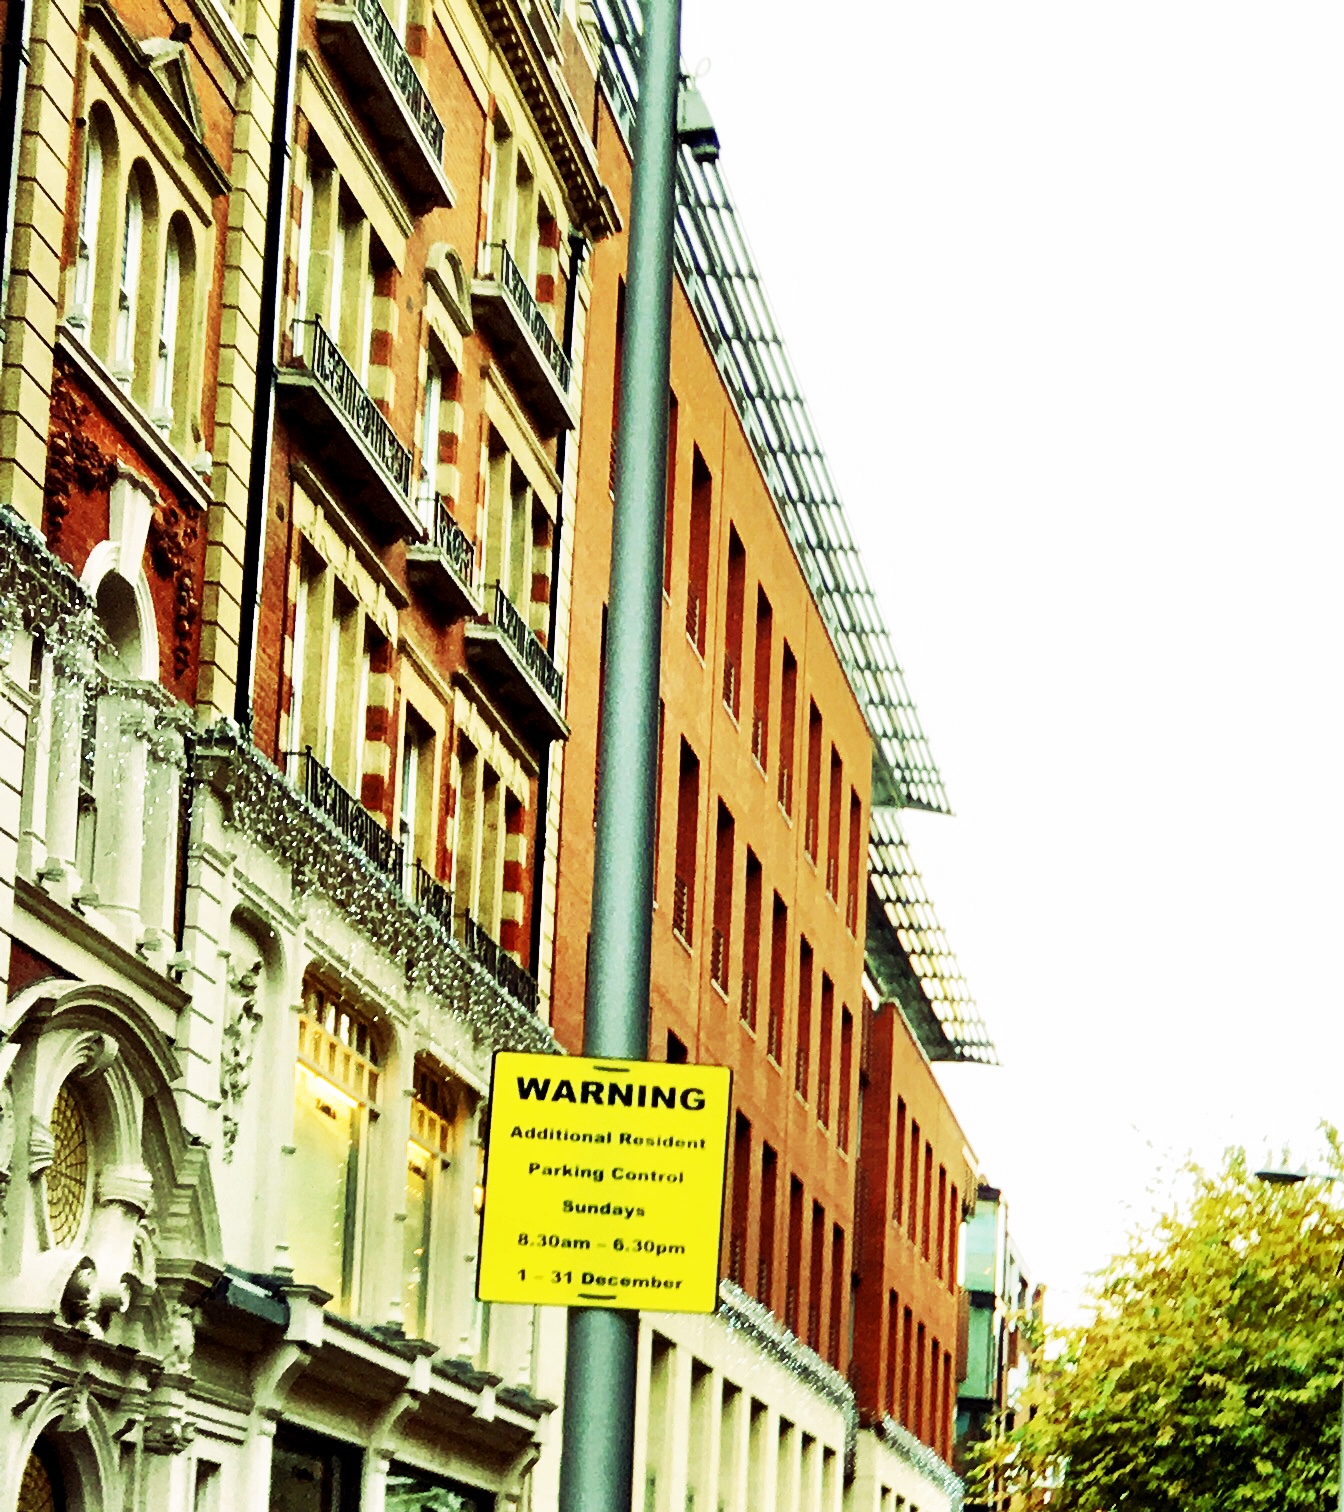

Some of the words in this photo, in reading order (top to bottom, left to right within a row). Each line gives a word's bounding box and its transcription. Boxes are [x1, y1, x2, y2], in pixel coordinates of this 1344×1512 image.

[516, 1076, 706, 1111] WARNING
[510, 1125, 612, 1144] Additional
[619, 1132, 706, 1150] Resident
[528, 1162, 604, 1182] Parking
[611, 1167, 684, 1184] Control
[562, 1199, 645, 1220] Sundays
[517, 1232, 591, 1250] 8.30am
[612, 1237, 686, 1256] 6.30pm
[517, 1269, 526, 1282] 1
[551, 1270, 573, 1285] 31
[581, 1271, 684, 1289] December
